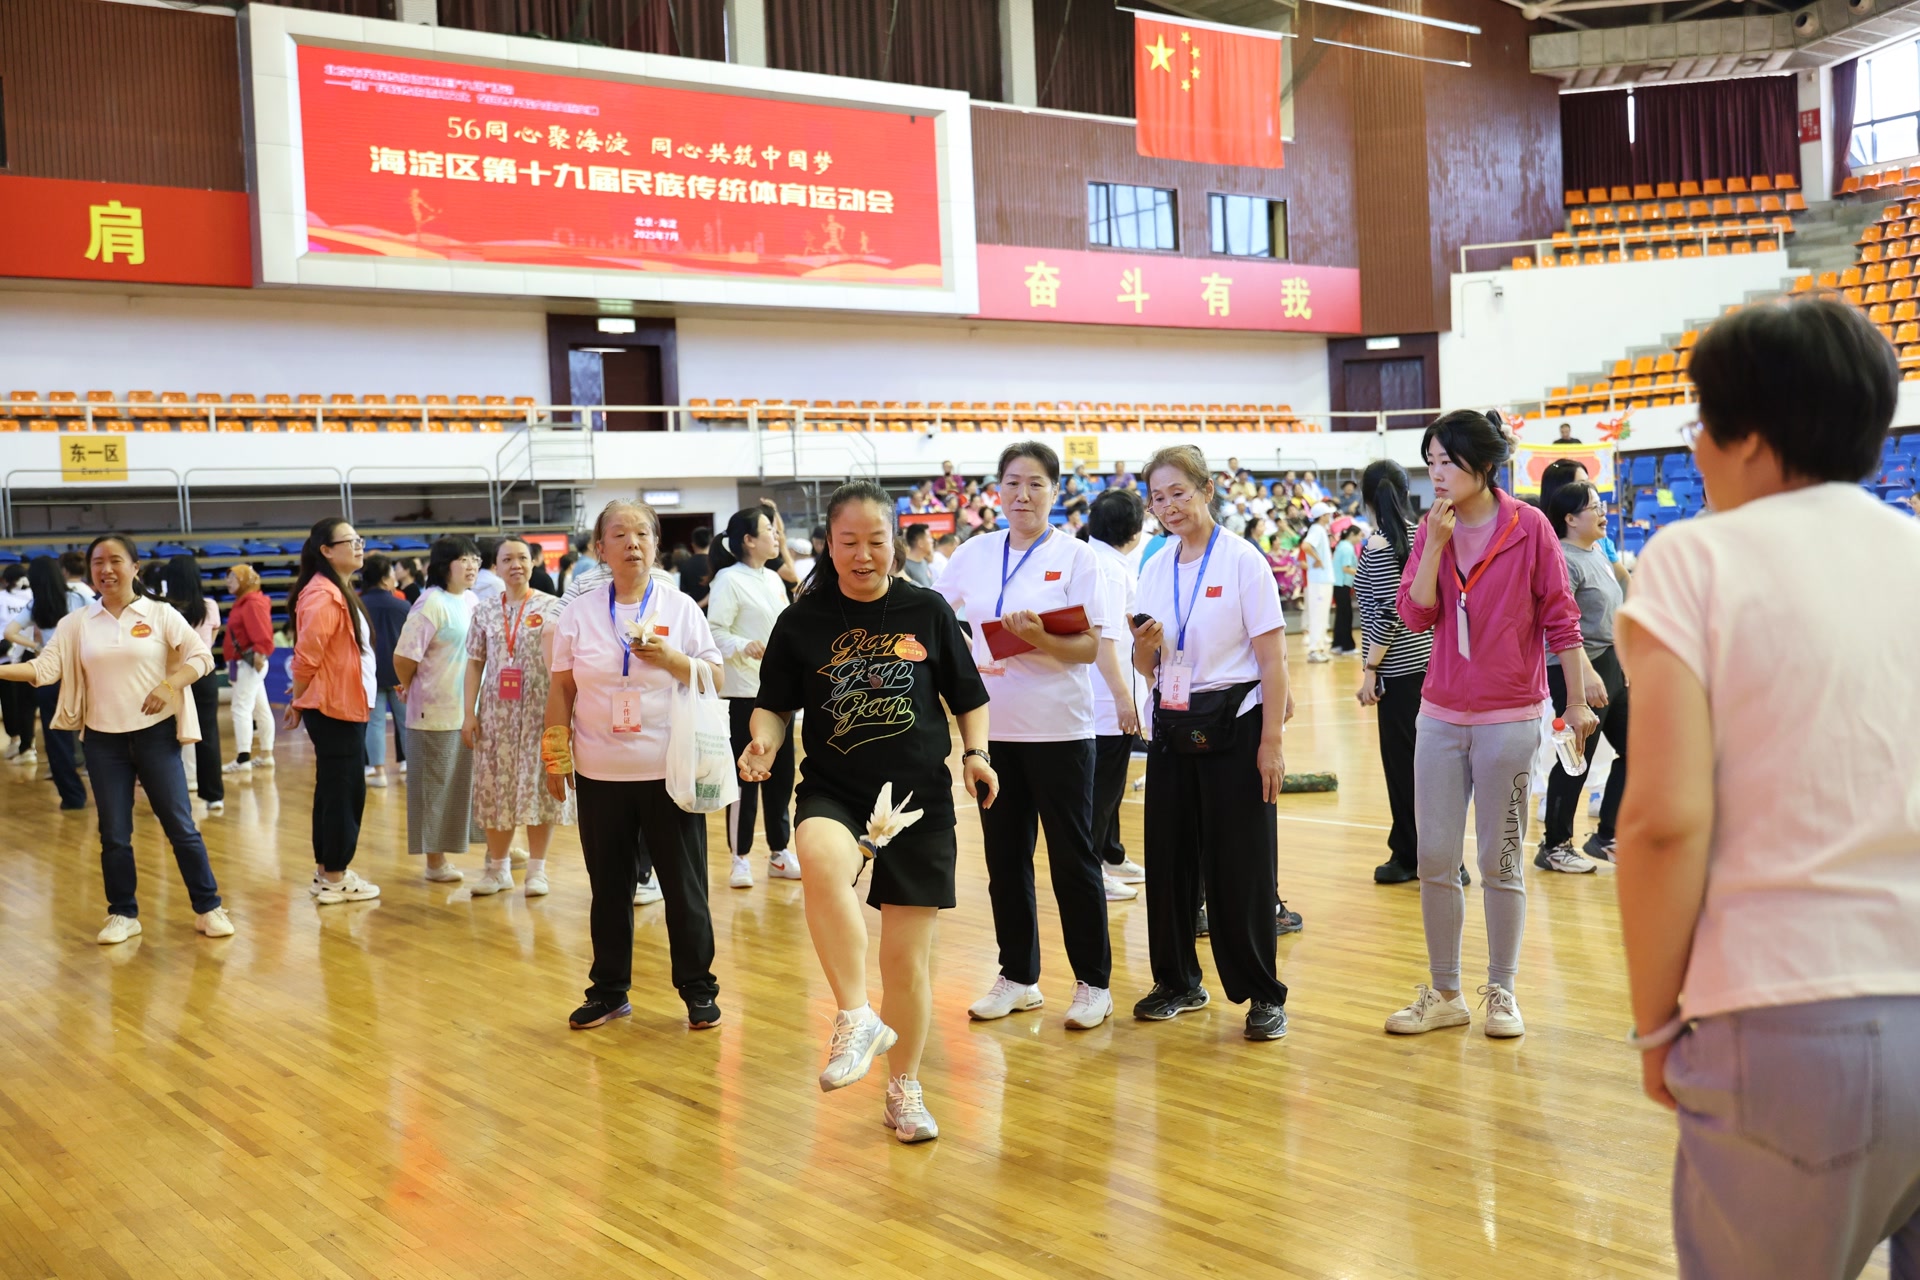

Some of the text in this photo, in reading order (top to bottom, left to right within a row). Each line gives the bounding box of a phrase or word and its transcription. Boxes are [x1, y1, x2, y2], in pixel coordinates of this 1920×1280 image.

[446, 116, 834, 176] 56同心聚海淀 同心共筑中国梦
[369, 145, 895, 215] 海淀区第十九届民族传统体育运动会
[84, 200, 146, 265] 肩
[70, 443, 119, 463] 东一区
[1499, 771, 1529, 882] Calvin Klein
